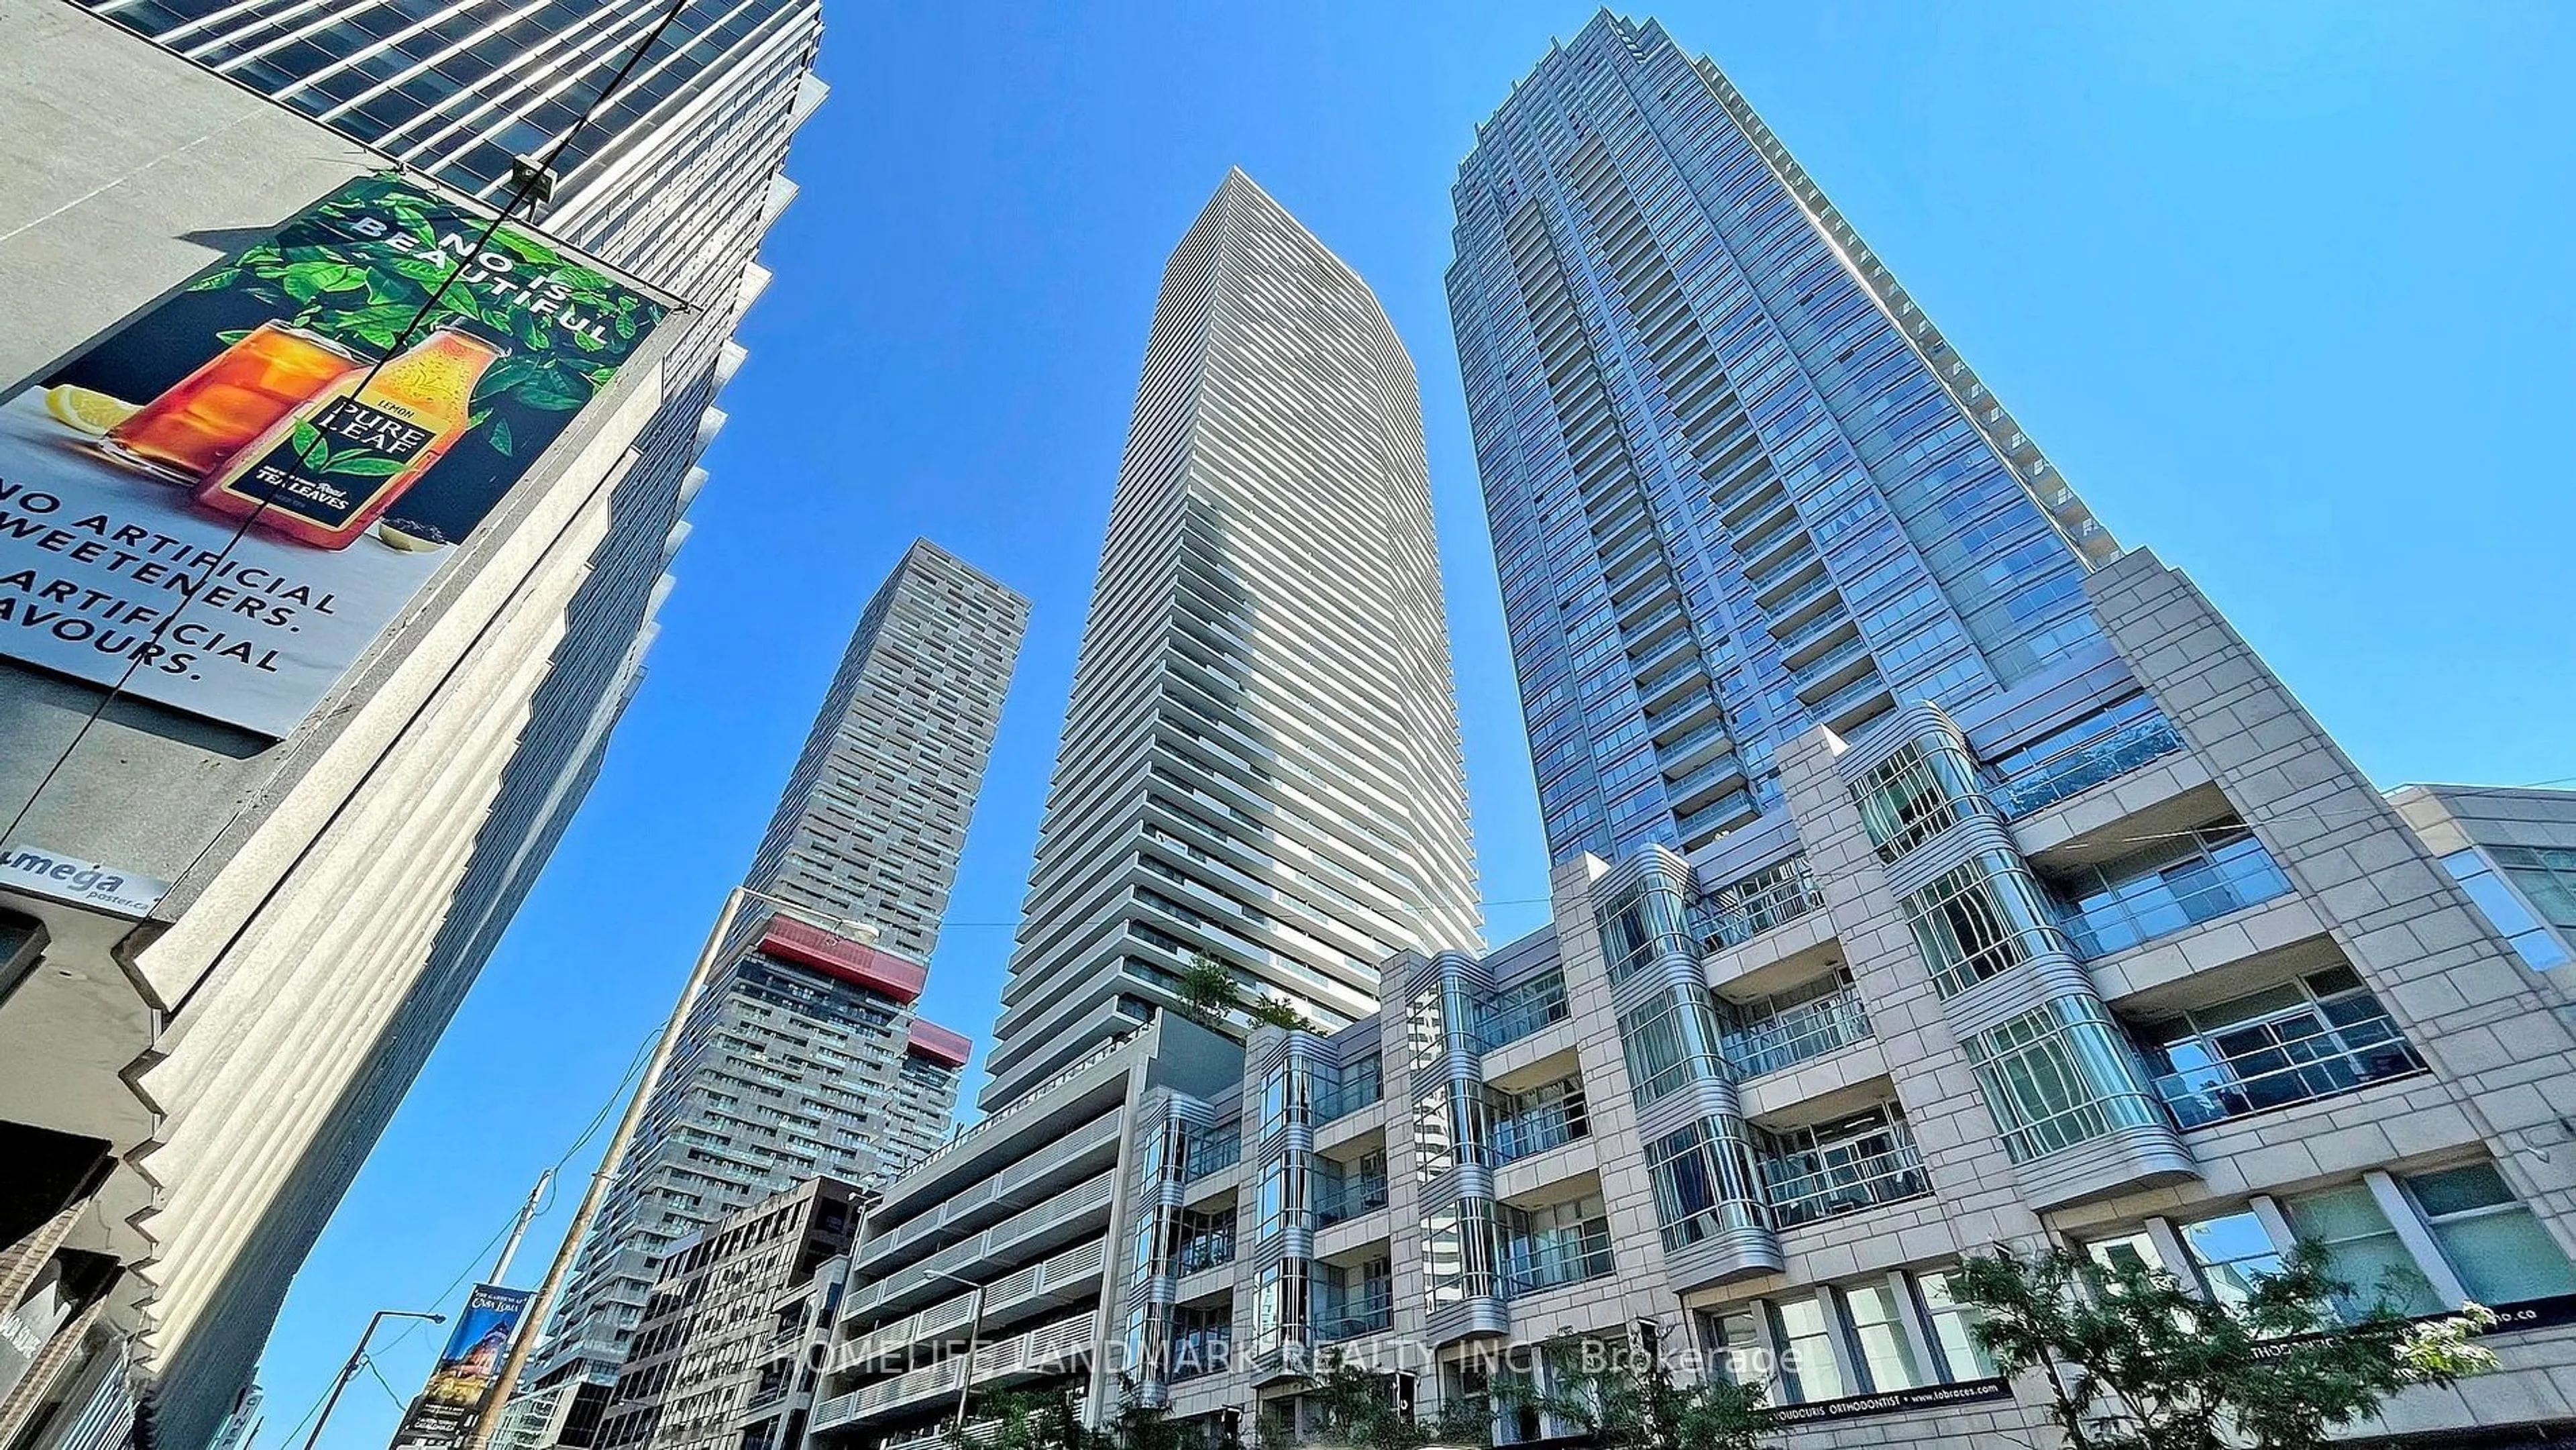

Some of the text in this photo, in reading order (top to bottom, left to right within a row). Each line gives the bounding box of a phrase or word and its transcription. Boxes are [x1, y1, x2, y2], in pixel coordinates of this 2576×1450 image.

[352, 215, 608, 345] BEAUTIFUL
[439, 232, 572, 301] NO IS
[331, 401, 426, 446] PURE
[377, 399, 415, 419] LEMON
[318, 413, 414, 454] LEAF
[288, 482, 350, 510] LEAVES
[72, 515, 335, 615] ARTIFICIAL
[0, 570, 279, 673] ARTIFICIAL
[9, 852, 125, 892] mega
[85, 890, 148, 910] poster.ca
[1829, 1395, 1901, 1414] ORTHODONTIST
